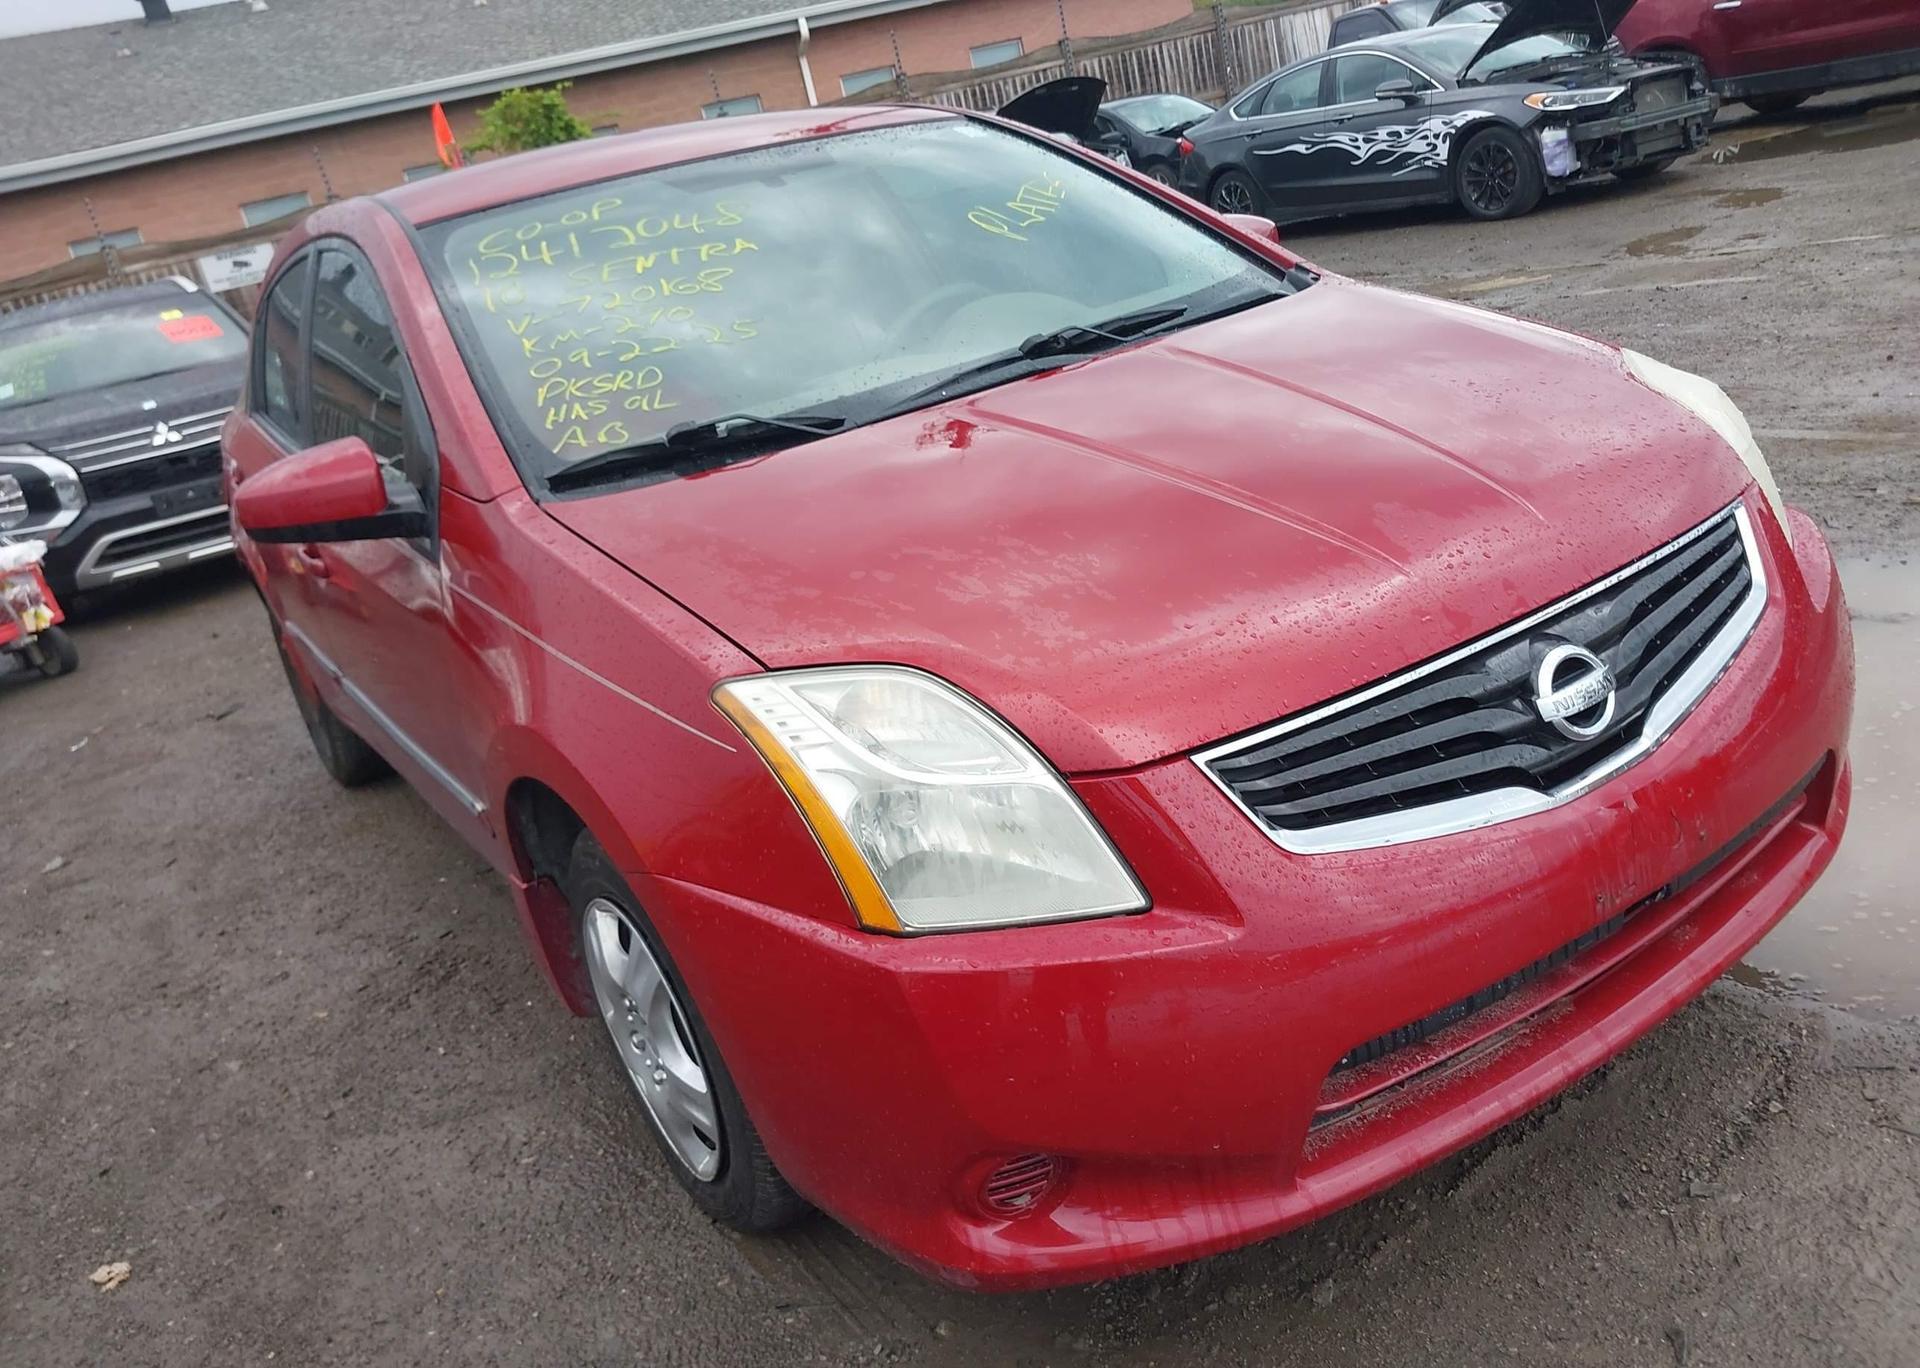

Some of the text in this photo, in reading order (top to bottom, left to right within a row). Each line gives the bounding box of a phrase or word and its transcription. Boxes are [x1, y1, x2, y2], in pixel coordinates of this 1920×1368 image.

[568, 238, 759, 284] SENTRA
[545, 400, 610, 429] HAS
[1553, 671, 1614, 714] NISSAN
